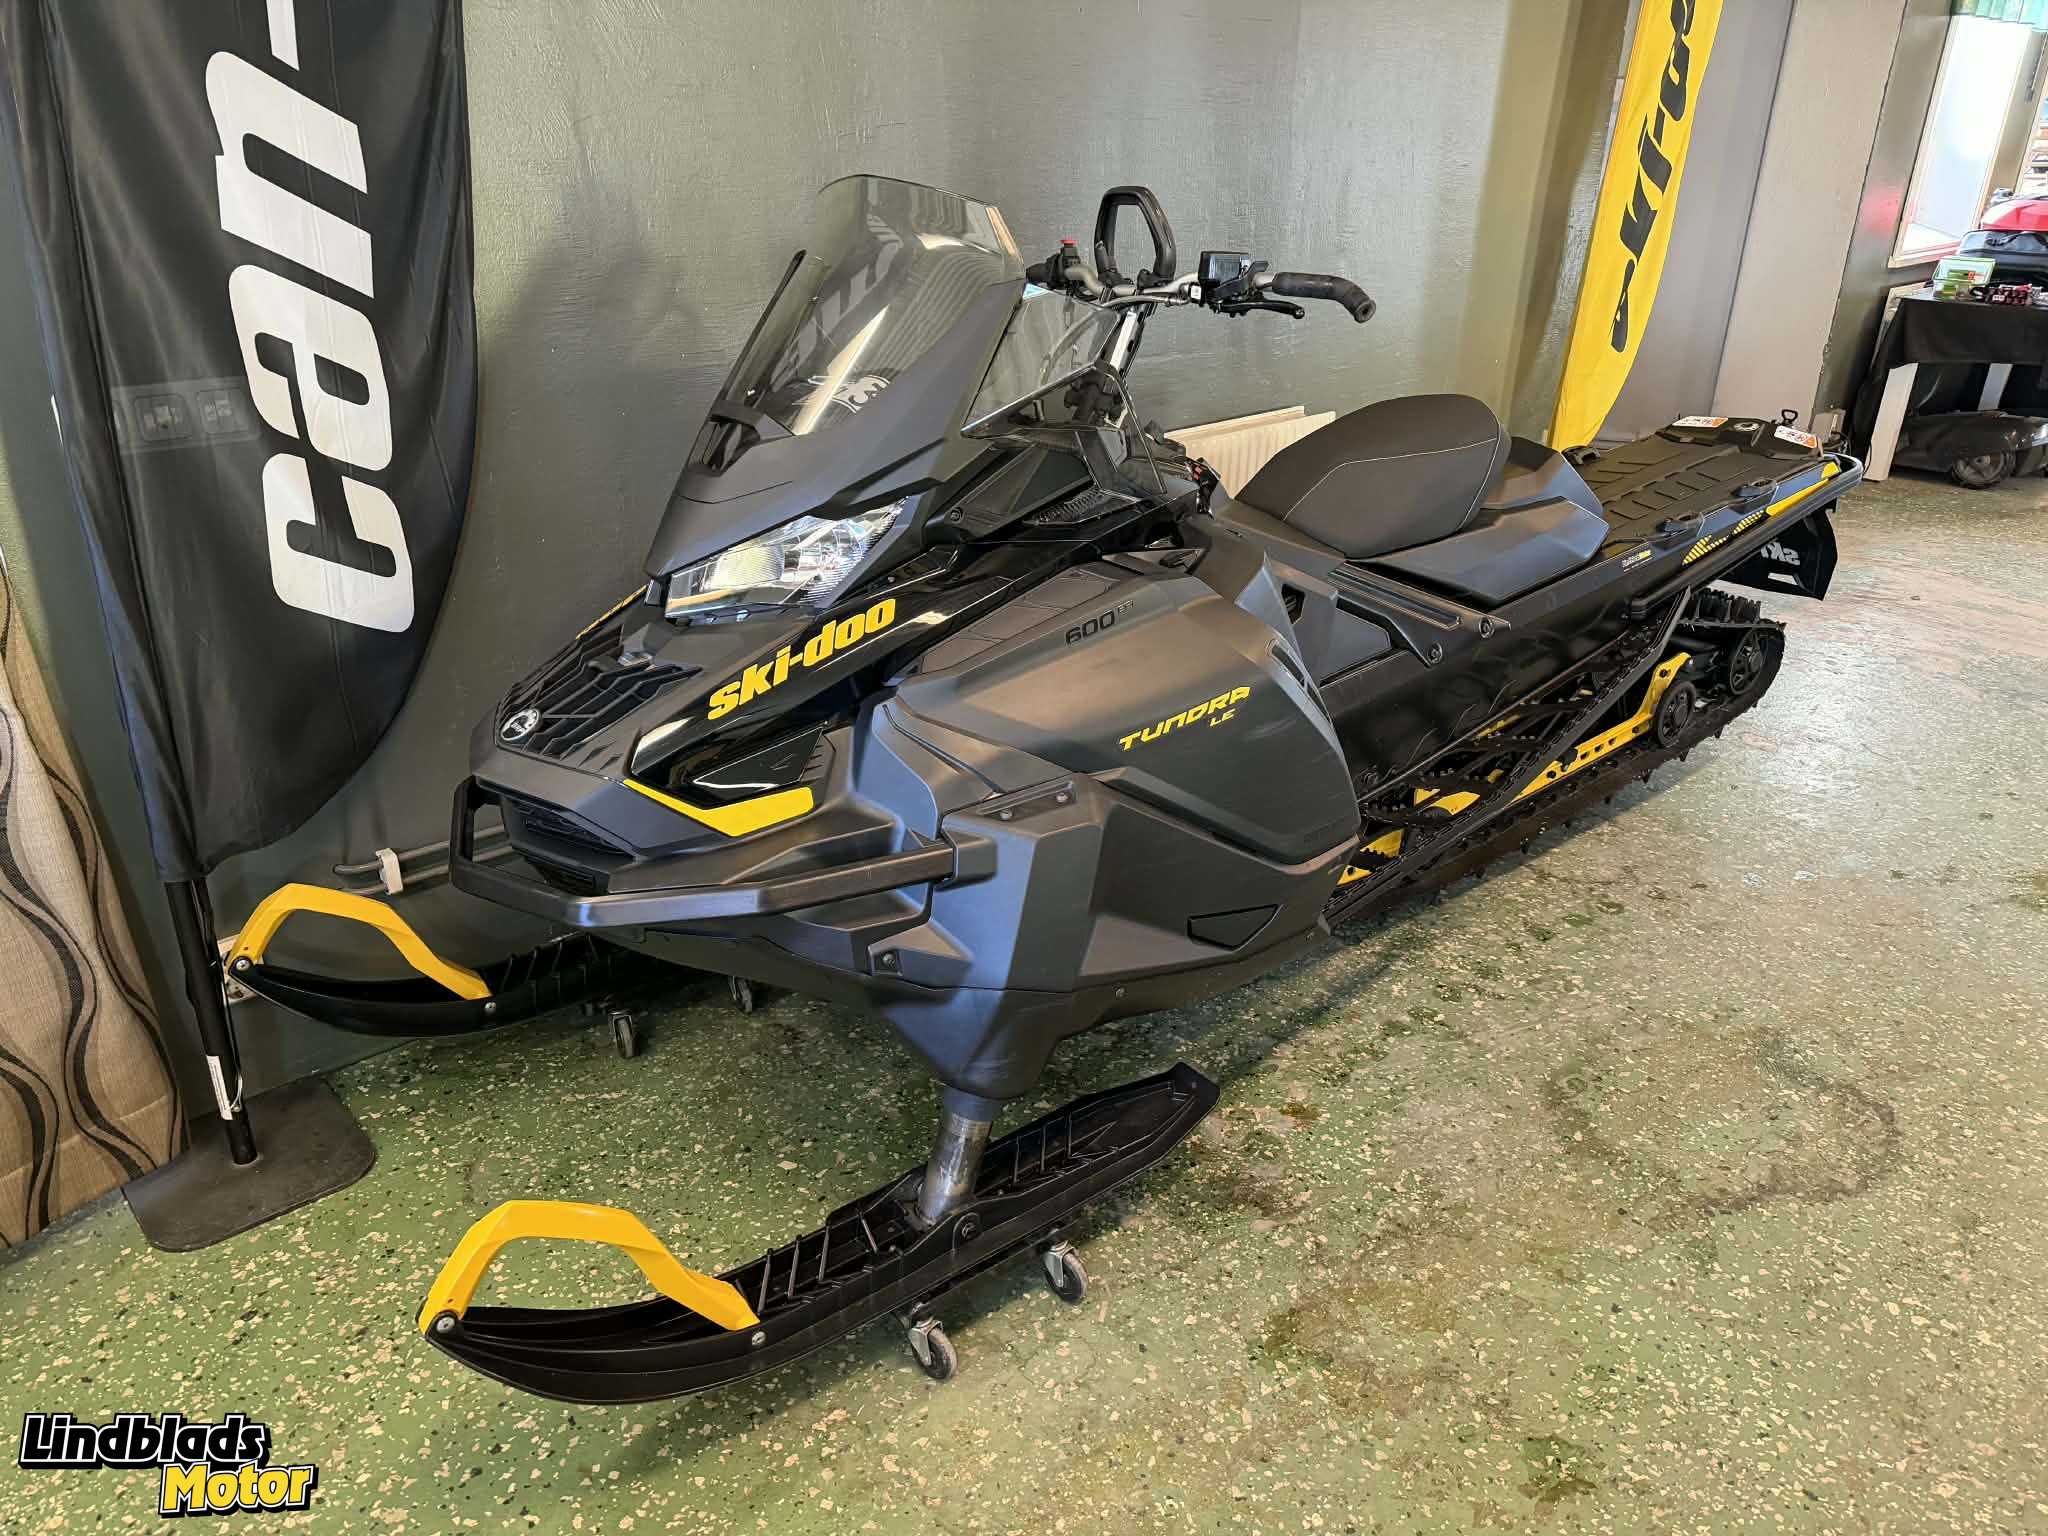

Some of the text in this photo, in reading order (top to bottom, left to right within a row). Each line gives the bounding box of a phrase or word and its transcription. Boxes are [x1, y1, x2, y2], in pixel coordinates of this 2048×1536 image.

[1065, 611, 1115, 644] 600
[707, 598, 897, 720] ski-doo
[1119, 686, 1251, 752] TUNDRA
[1209, 708, 1237, 727] LE
